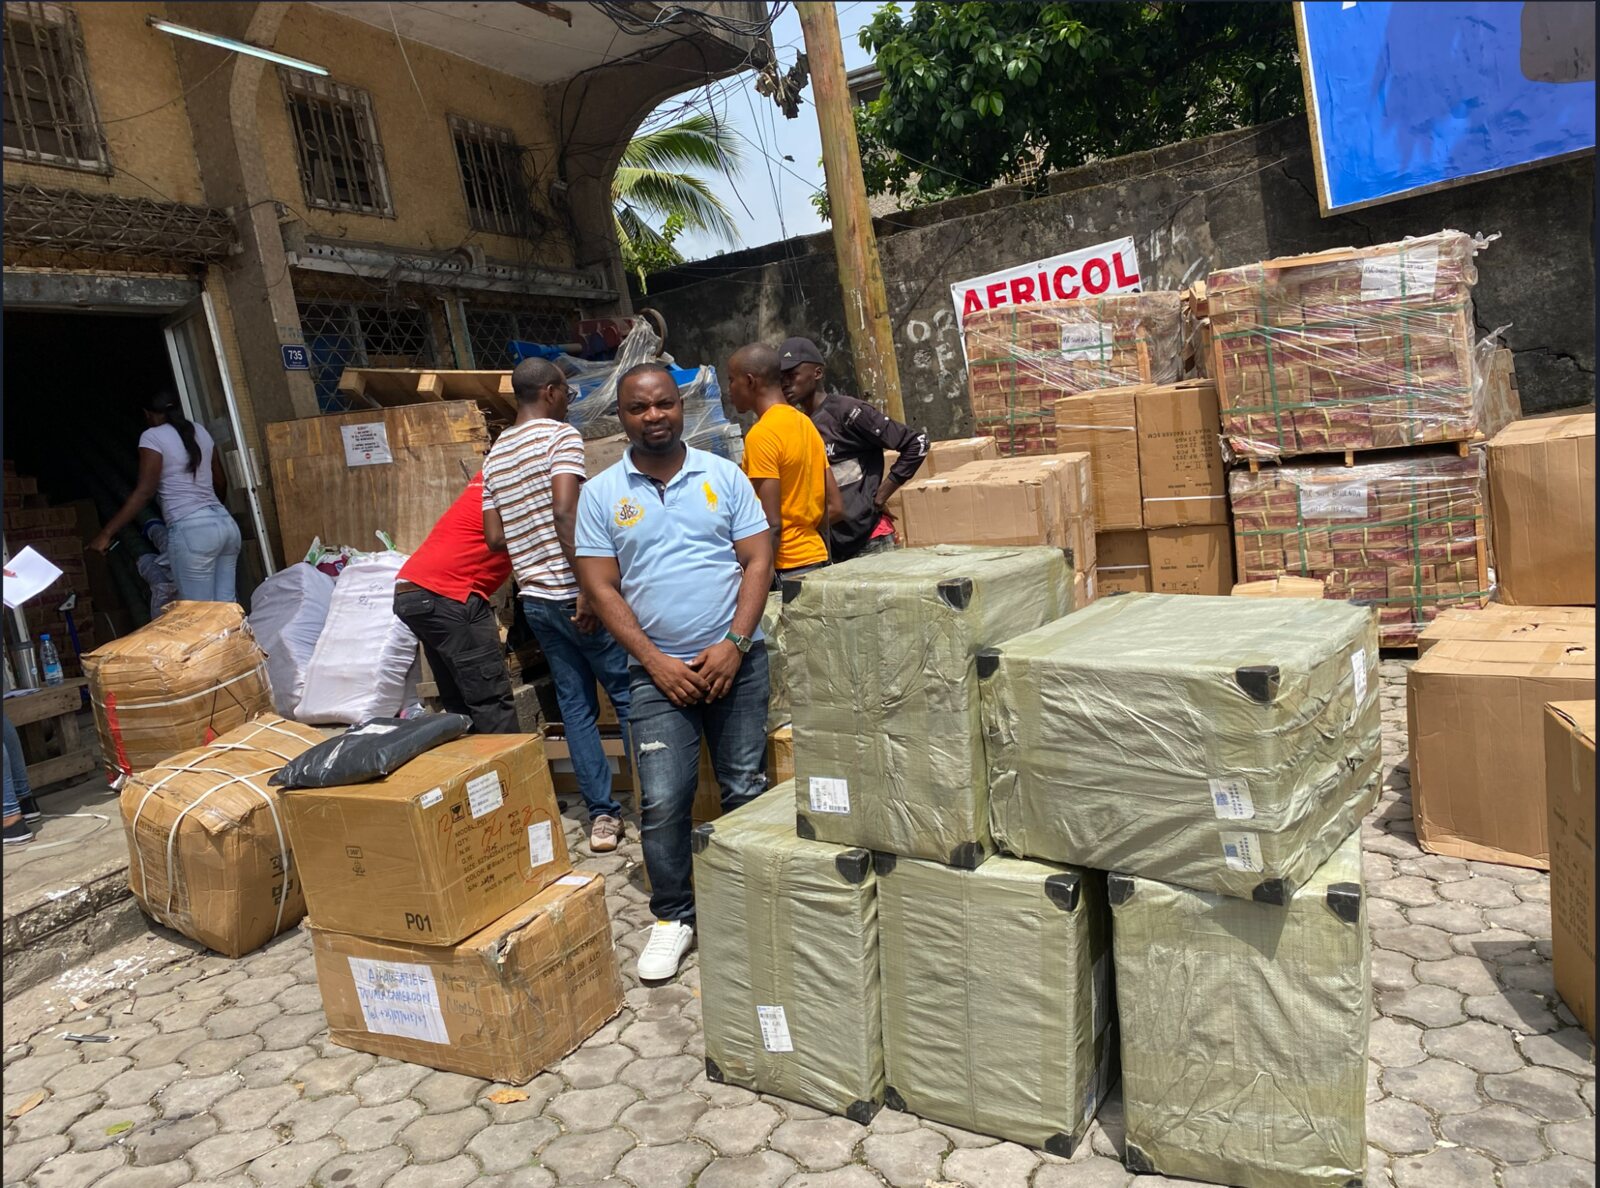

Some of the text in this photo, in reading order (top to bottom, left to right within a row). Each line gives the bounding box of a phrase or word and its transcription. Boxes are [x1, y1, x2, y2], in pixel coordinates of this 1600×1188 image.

[963, 252, 1140, 318] AFRICOL
[288, 350, 303, 361] 735
[405, 912, 432, 933] P01
